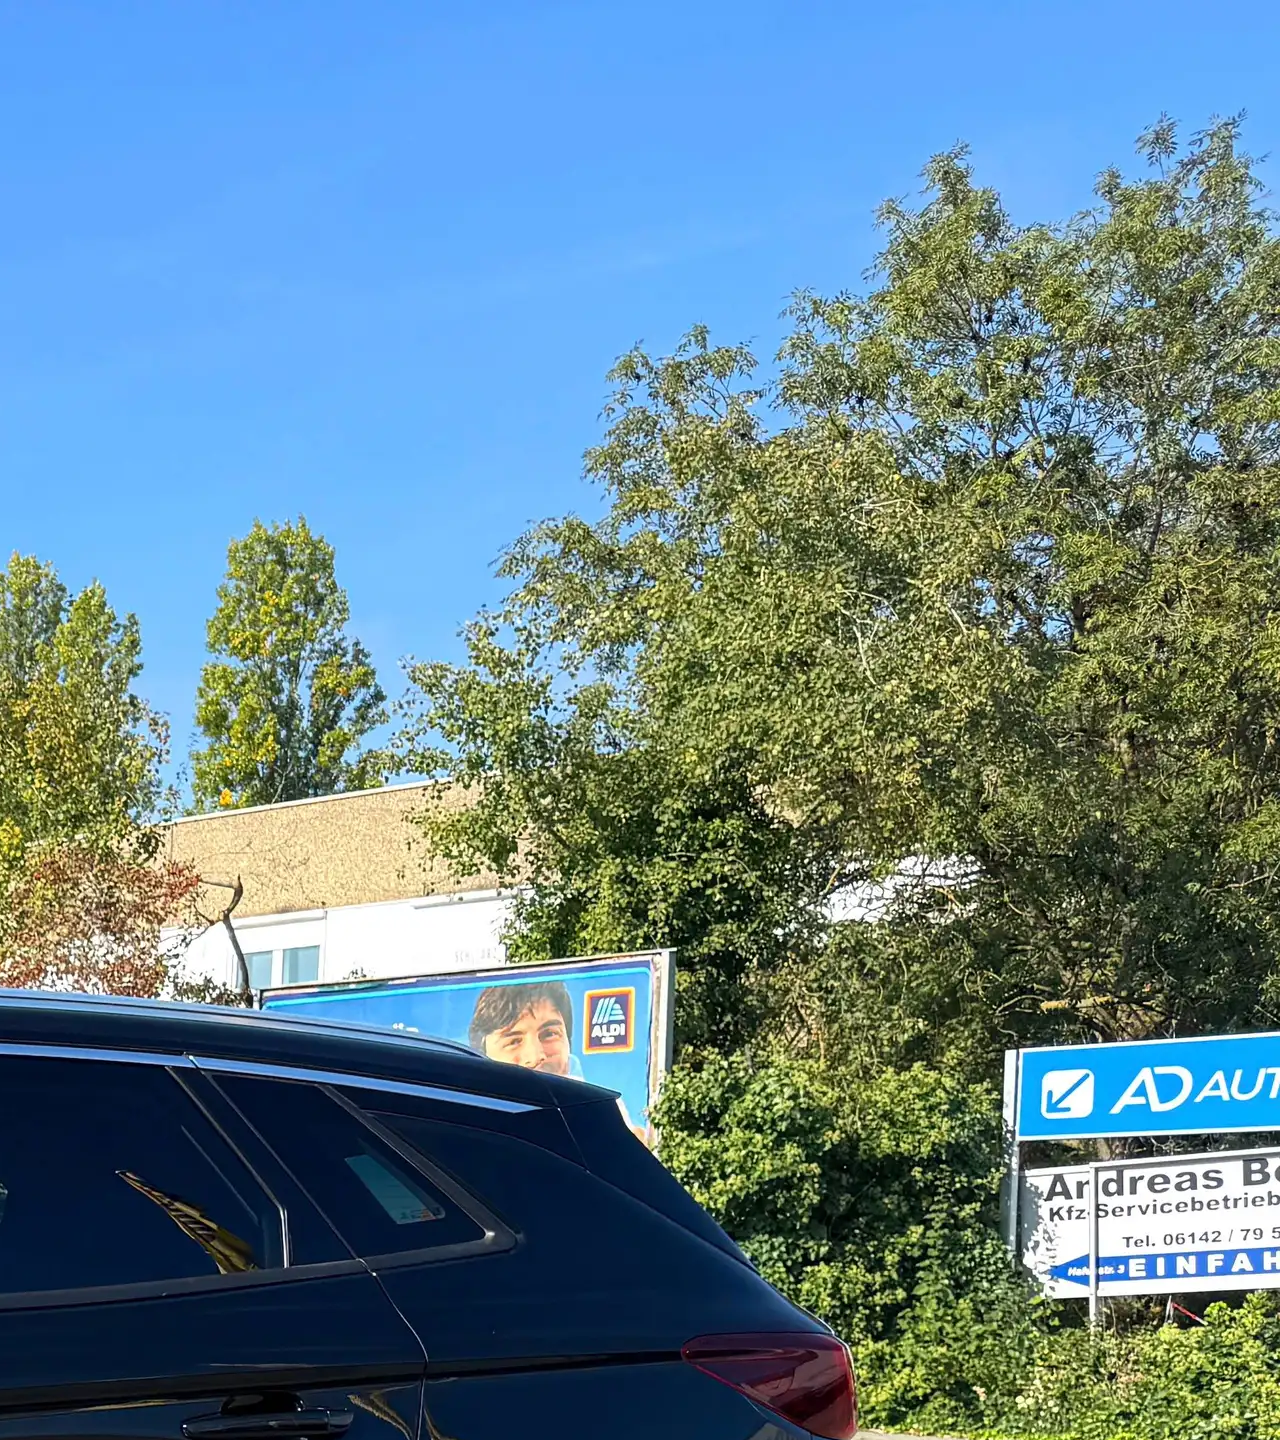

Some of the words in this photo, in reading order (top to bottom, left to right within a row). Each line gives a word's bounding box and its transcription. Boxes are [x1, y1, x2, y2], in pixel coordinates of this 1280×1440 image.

[591, 1022, 626, 1038] ALDI
[1108, 1065, 1194, 1115] AD
[1193, 1066, 1280, 1103] AUT
[1044, 1169, 1224, 1202] Andreas
[1122, 1235, 1156, 1248] Tel.
[1163, 1230, 1223, 1246] 06142
[1228, 1229, 1234, 1242] /
[1240, 1227, 1264, 1241] 79
[1128, 1250, 1280, 1278] EINFAH
